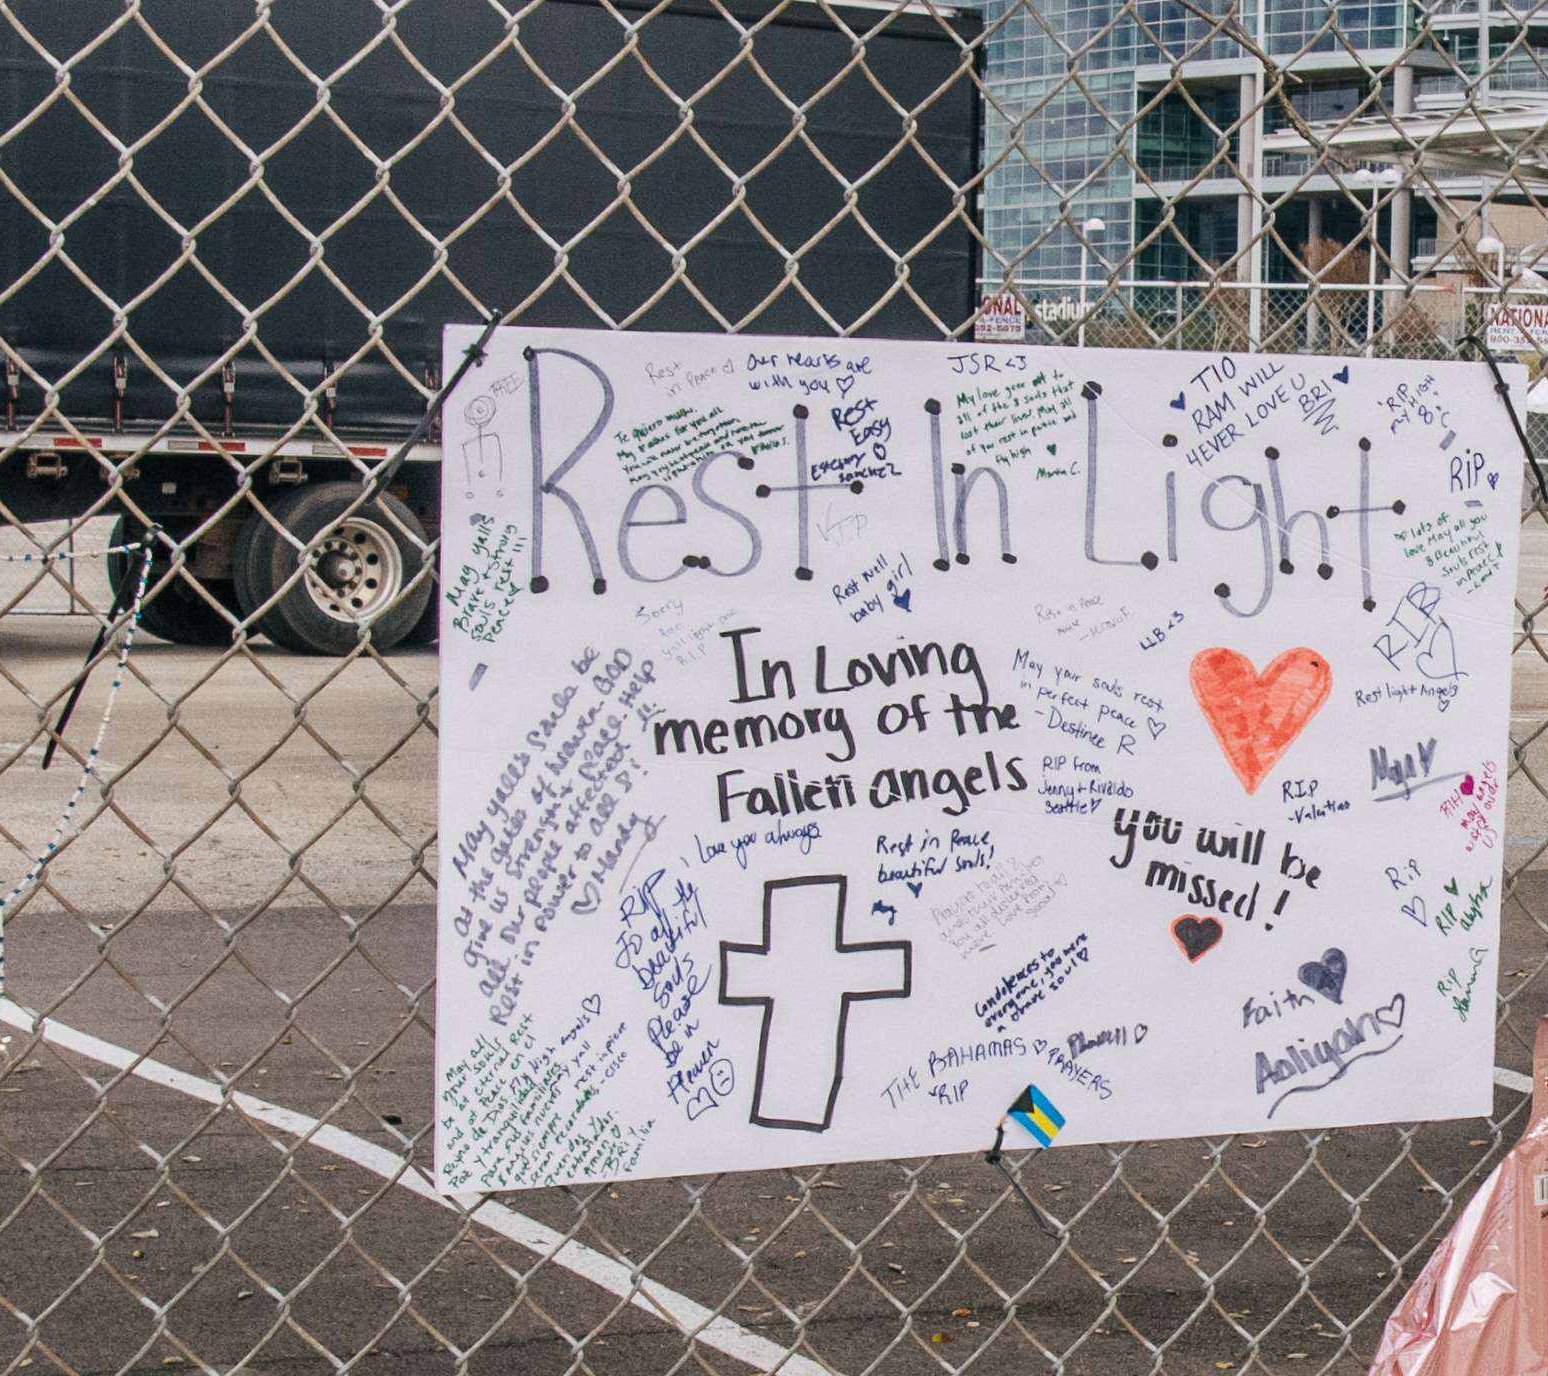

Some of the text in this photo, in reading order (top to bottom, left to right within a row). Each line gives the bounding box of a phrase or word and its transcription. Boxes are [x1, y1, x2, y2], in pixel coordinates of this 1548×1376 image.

[748, 376, 831, 396] with you
[785, 350, 842, 372] hearts
[845, 354, 874, 376] are
[1186, 423, 1246, 468] 4EVER
[1249, 386, 1289, 430] LOVE
[1190, 361, 1286, 436] RAM WILL
[522, 345, 1407, 619] Rest In Light
[848, 594, 885, 626] baby
[718, 625, 798, 704] In
[814, 634, 991, 708] Loving
[1012, 647, 1166, 714] May your souls rest
[654, 691, 1022, 764] memory of the
[1036, 683, 1091, 711] perfect
[1096, 703, 1139, 730] peace
[1041, 754, 1102, 775] RIP from
[1115, 733, 1138, 757] R
[715, 750, 1030, 825] Fallen angels
[875, 831, 914, 856] Rest
[919, 828, 941, 853] in
[877, 855, 949, 885] beautiful
[1109, 806, 1323, 889] you will be
[1241, 988, 1316, 1030] Faith
[880, 1064, 923, 1111] THE
[927, 1037, 1028, 1079] BAHAMAS
[1047, 1047, 1113, 1101] PRAYERS
